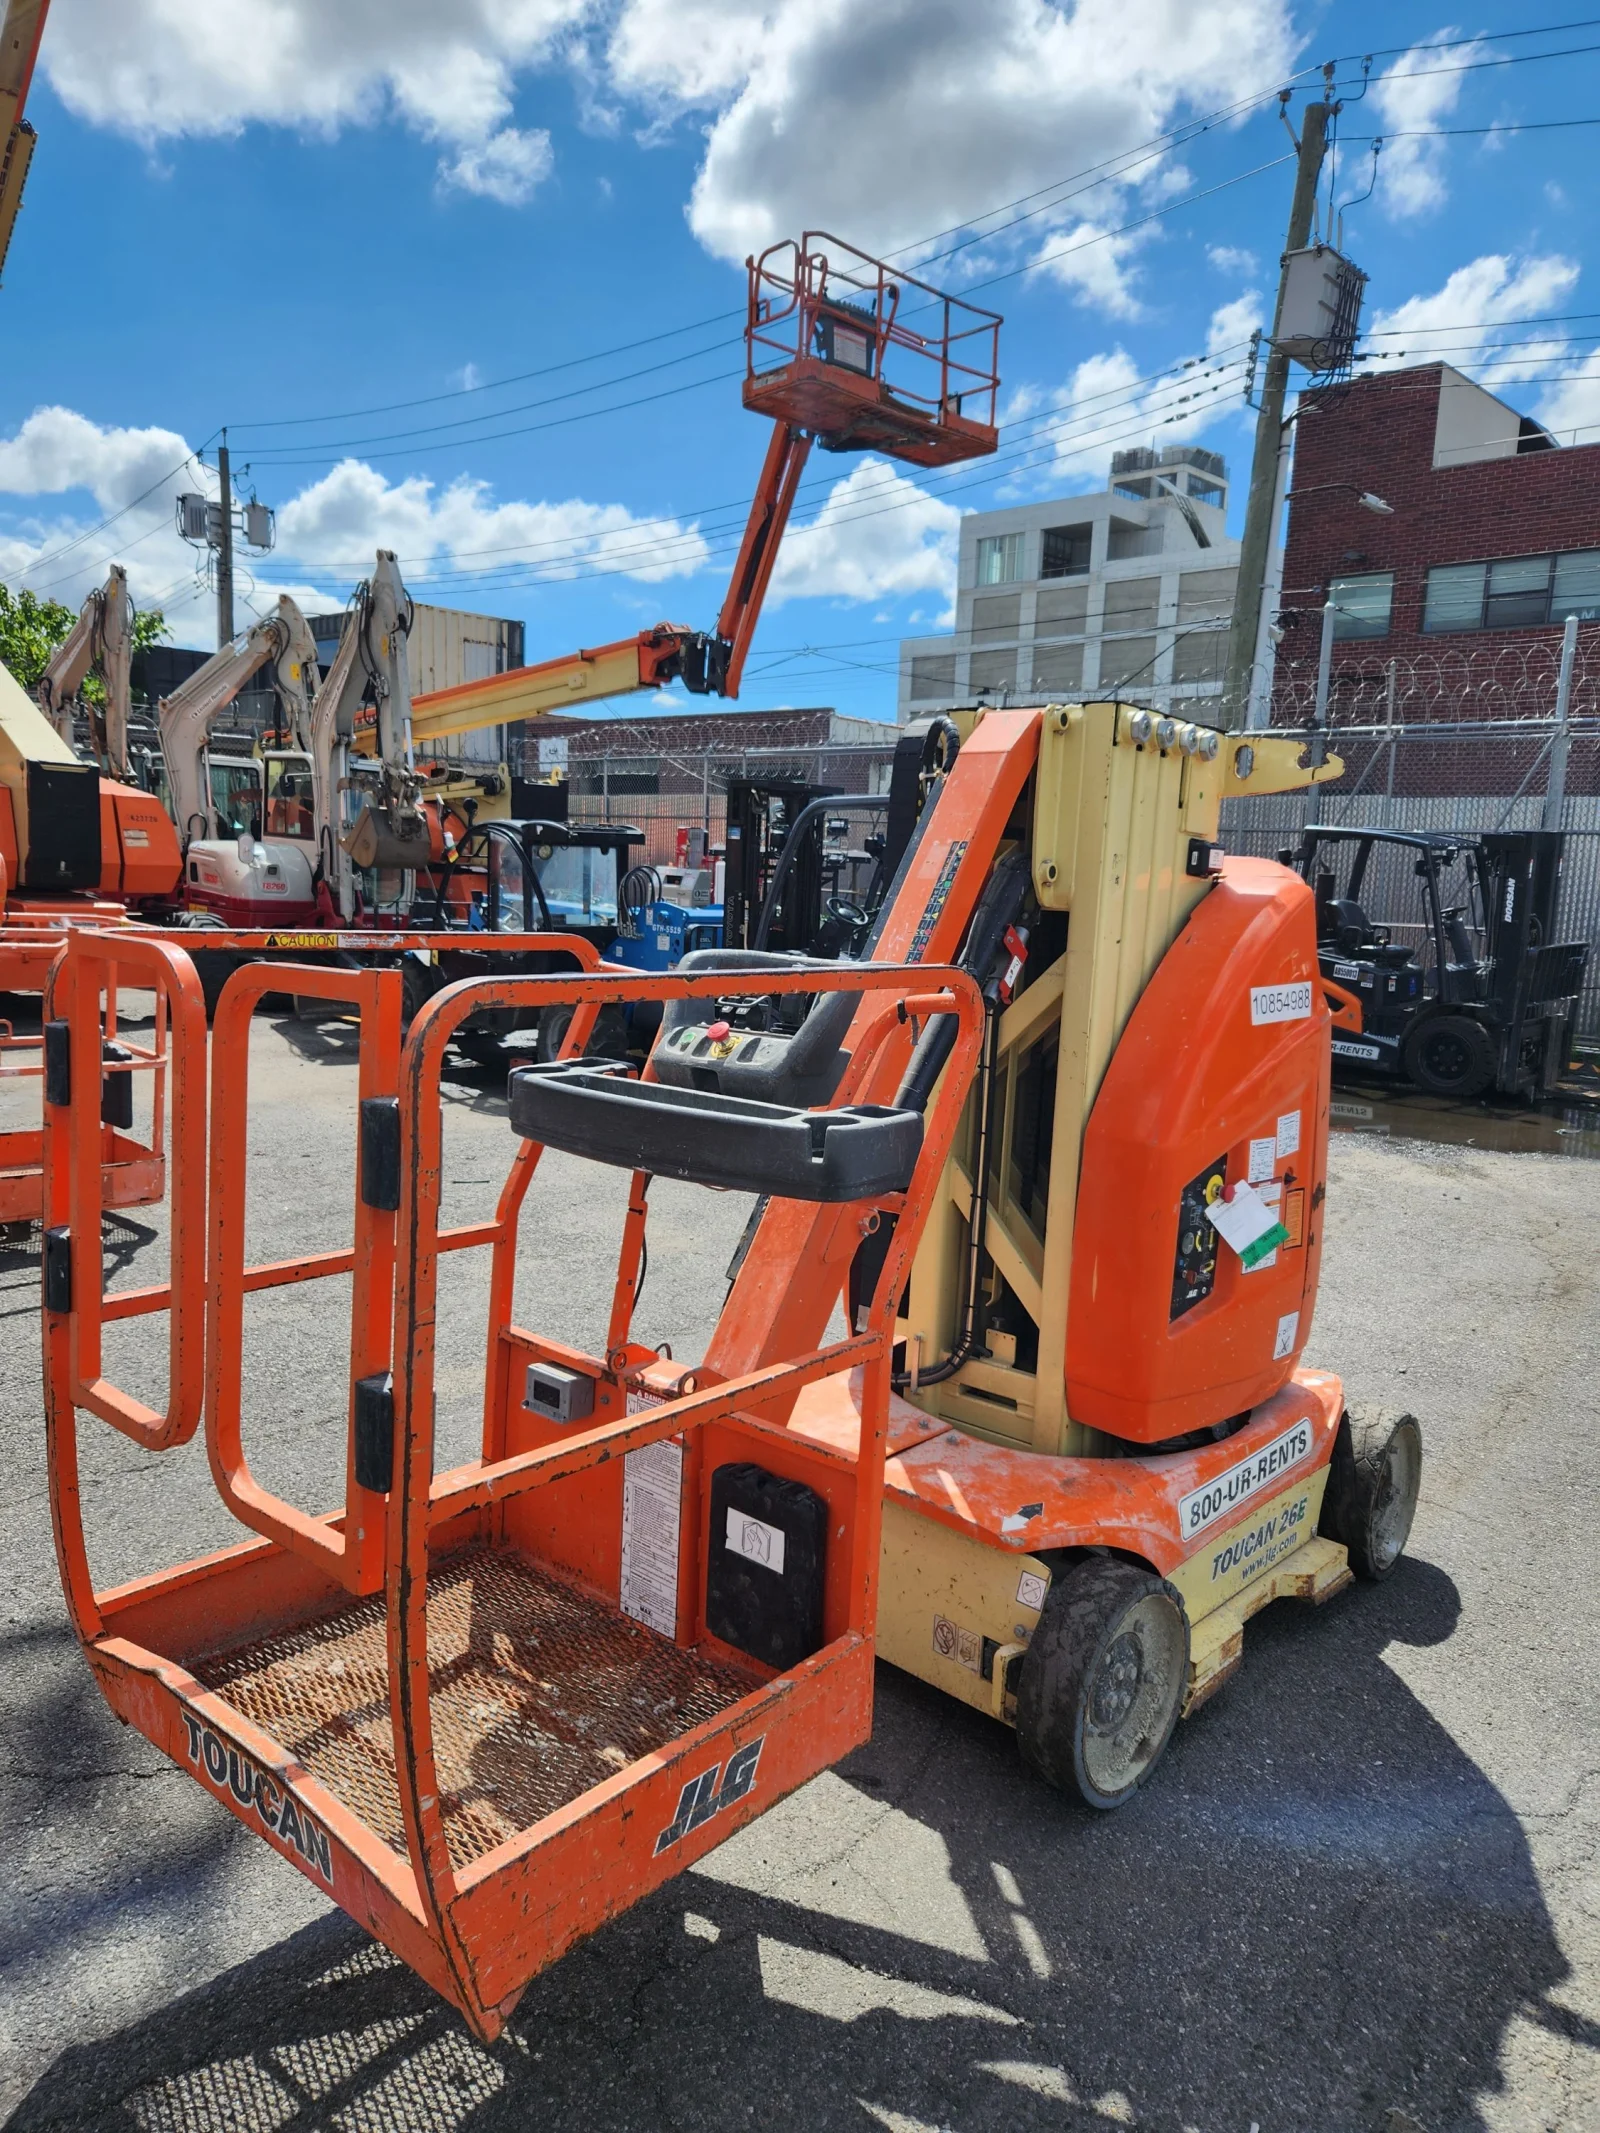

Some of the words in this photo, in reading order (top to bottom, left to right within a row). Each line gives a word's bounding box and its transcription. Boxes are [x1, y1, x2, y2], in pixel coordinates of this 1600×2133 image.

[726, 895, 735, 947] TOYOTA
[1504, 877, 1516, 923] DOOSAN
[279, 935, 335, 947] CAUTION
[1253, 988, 1310, 1016] 10854988
[1190, 1428, 1307, 1528] 800-UR-RENTS
[1211, 1516, 1277, 1582] TOUCAN
[1278, 1496, 1308, 1535] 26E
[1241, 1531, 1297, 1580] www.jlg.com
[181, 1708, 333, 1886] TOUCAN
[652, 1733, 767, 1858] JLG
